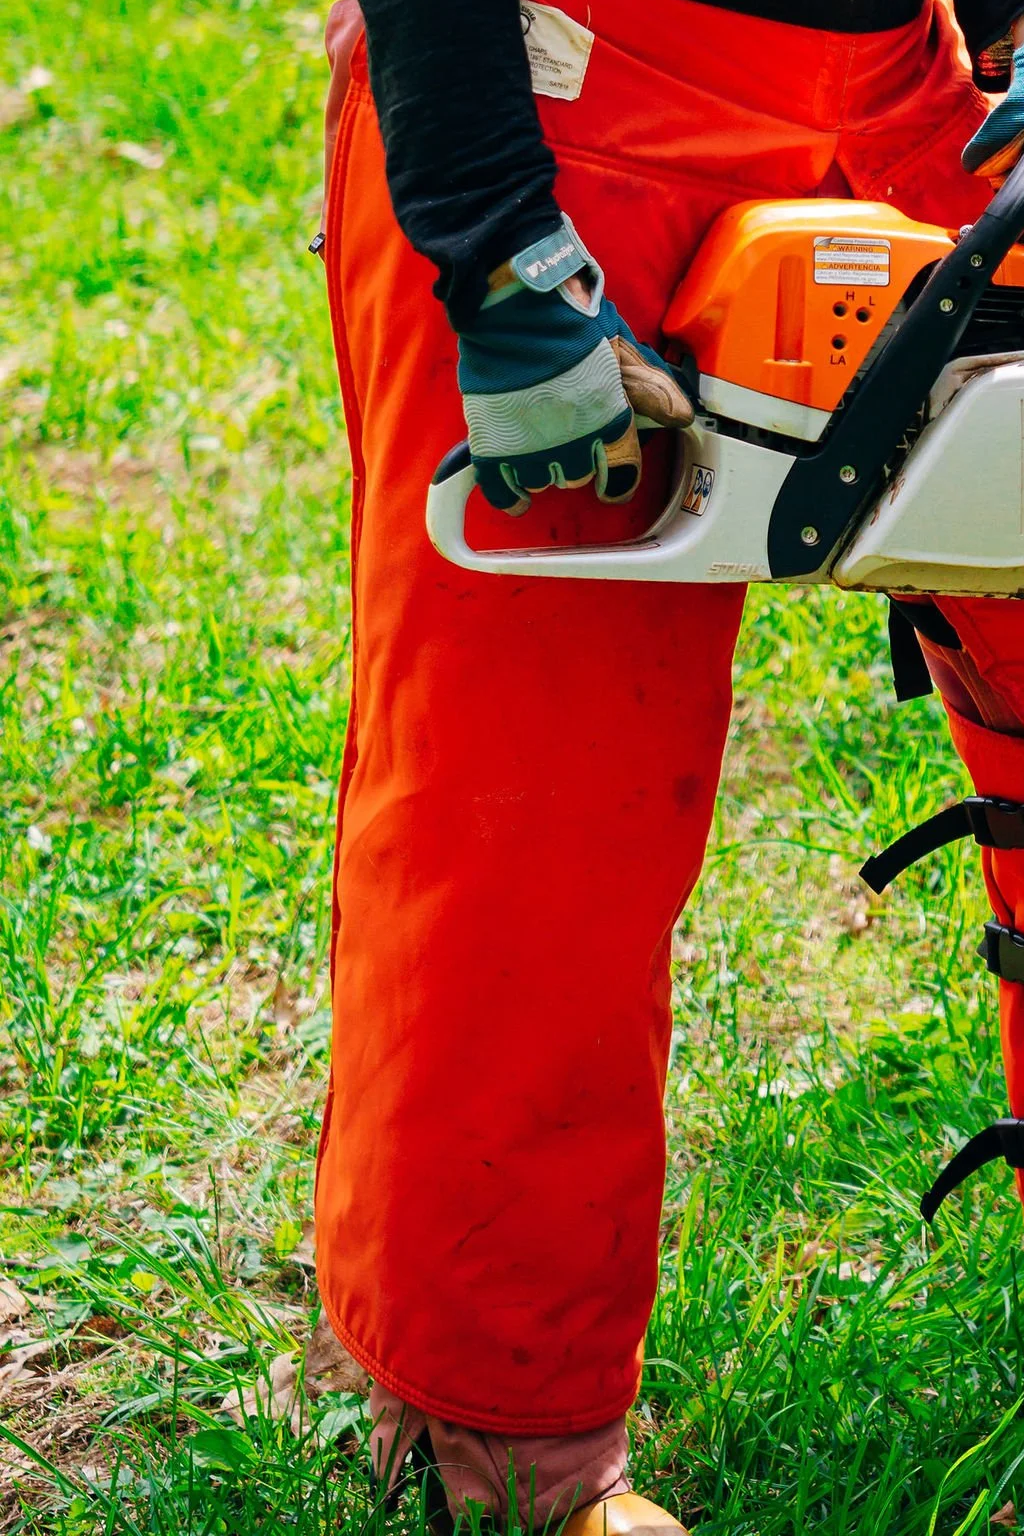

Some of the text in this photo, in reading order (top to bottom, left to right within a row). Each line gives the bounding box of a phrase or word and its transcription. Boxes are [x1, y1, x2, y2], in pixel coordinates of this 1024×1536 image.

[839, 245, 875, 253] WARNING
[828, 263, 881, 272] ADVERTENCIA
[846, 291, 855, 301] H
[869, 295, 876, 306] L
[830, 354, 847, 366] LA
